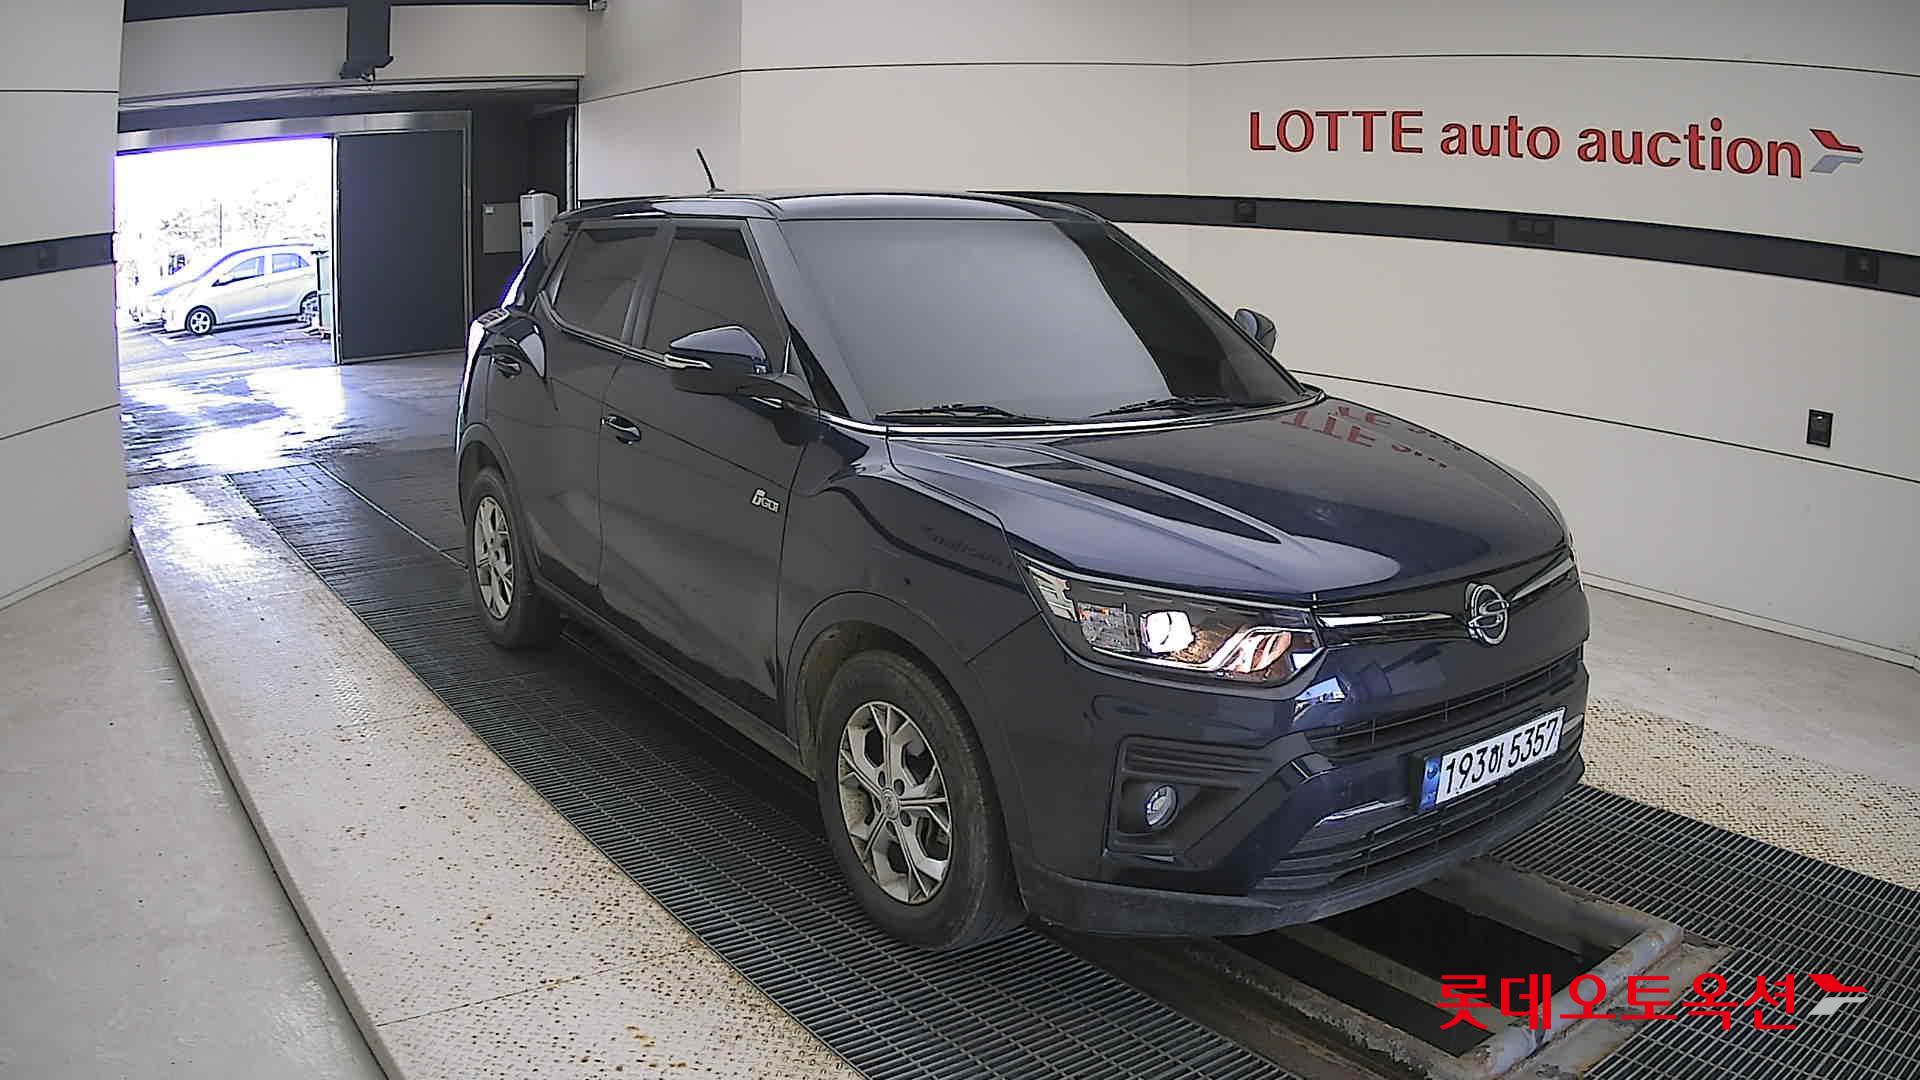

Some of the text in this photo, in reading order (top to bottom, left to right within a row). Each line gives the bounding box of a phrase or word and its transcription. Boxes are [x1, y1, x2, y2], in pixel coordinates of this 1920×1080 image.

[1249, 110, 1803, 178] LOTTE auto auction
[1446, 718, 1557, 794] 193하 5357
